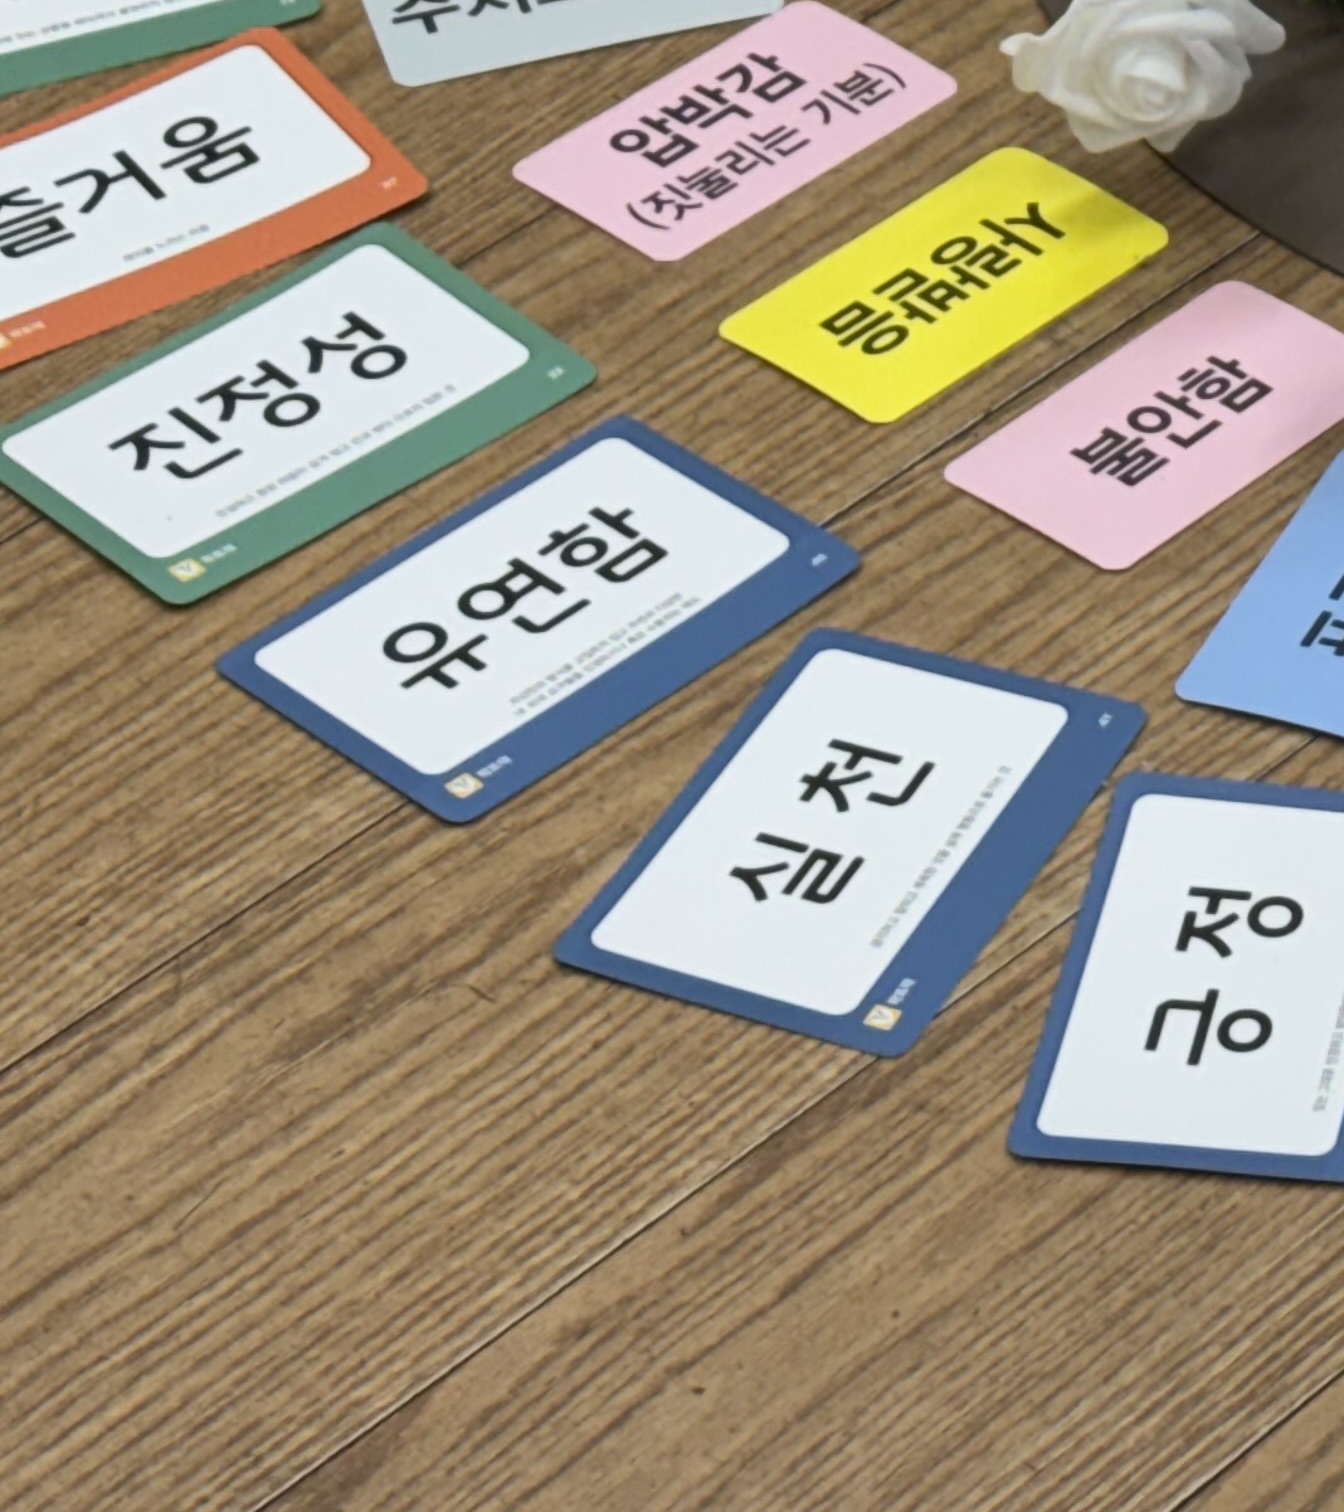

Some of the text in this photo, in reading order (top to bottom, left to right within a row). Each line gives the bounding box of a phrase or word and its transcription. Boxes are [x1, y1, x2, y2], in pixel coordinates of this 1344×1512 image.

[608, 51, 809, 171] 압박감
[626, 121, 812, 232] (짓눌리는
[0, 116, 260, 259] 즐거움
[818, 201, 1068, 356] 사랑받음
[109, 311, 408, 480] 진정성
[1069, 354, 1277, 488] 불안함
[382, 507, 668, 690] 유연함
